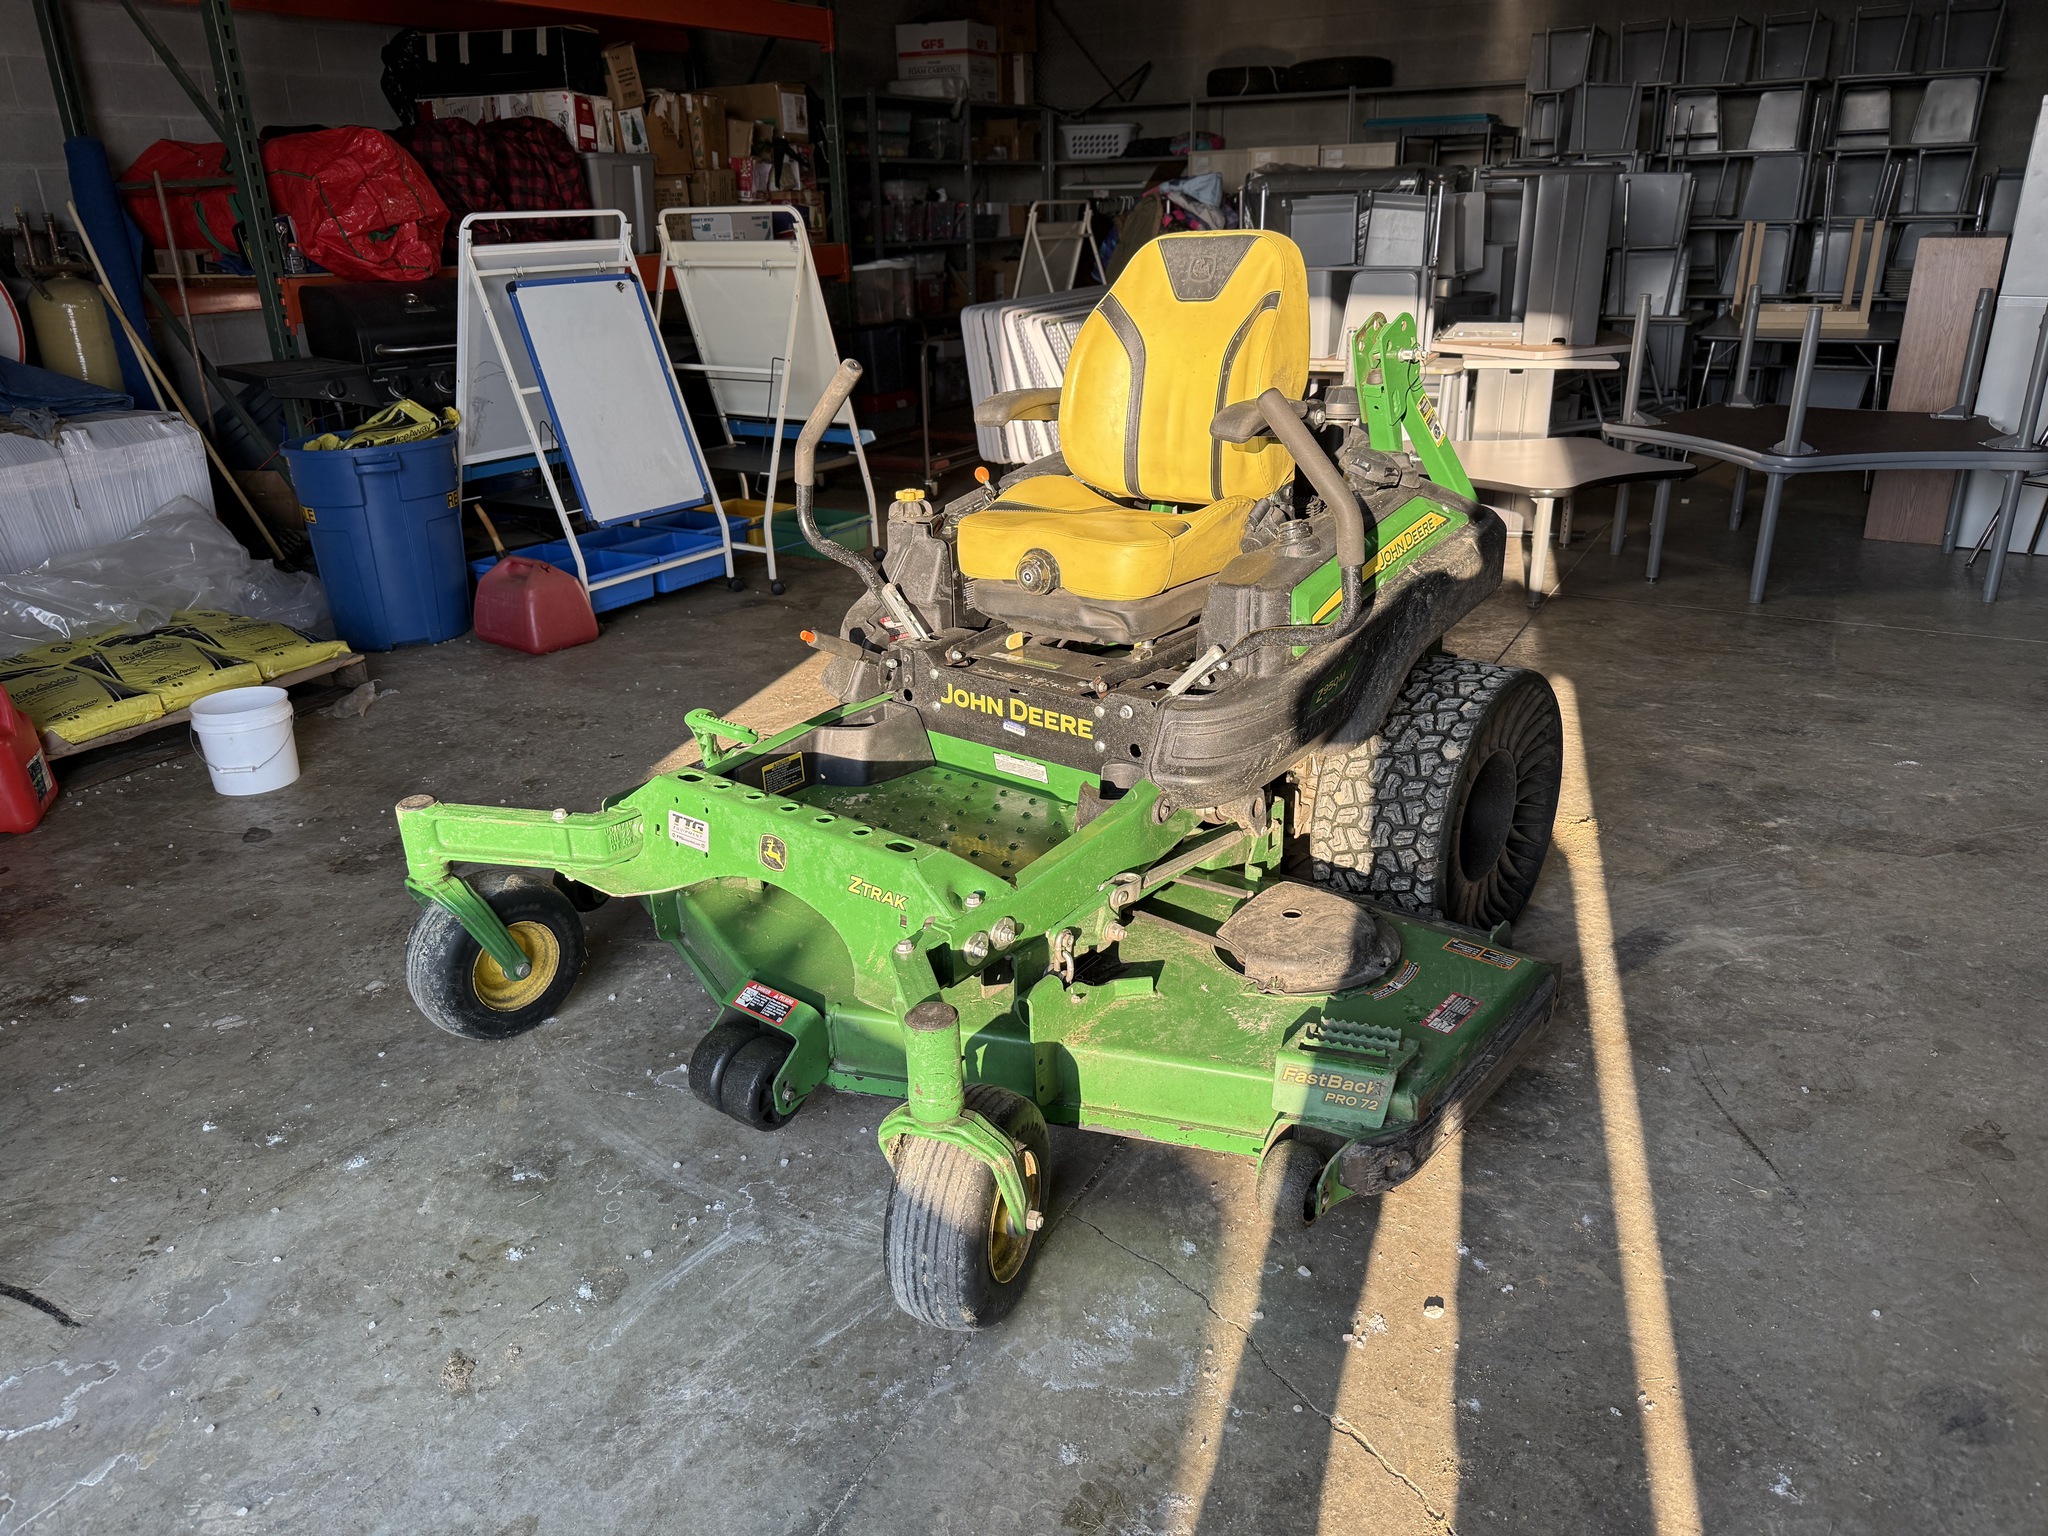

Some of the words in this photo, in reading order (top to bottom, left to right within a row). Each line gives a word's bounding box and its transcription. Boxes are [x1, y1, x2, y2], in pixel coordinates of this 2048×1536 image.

[921, 38, 945, 49] GFS
[908, 66, 926, 75] FOAM
[928, 64, 961, 75] CARRYOUT
[396, 423, 431, 443] IceAway
[1380, 540, 1405, 569] JOHN
[1404, 517, 1436, 548] DEERE
[940, 682, 1003, 717] JOHN
[1009, 697, 1094, 740] DEERE
[672, 813, 704, 832] TTG
[672, 825, 702, 838] EQUIPMENT
[847, 874, 909, 912] ZTRAK
[1281, 1066, 1378, 1095] FastBack
[1324, 1091, 1357, 1107] PRO
[1361, 1098, 1379, 1111] 72
